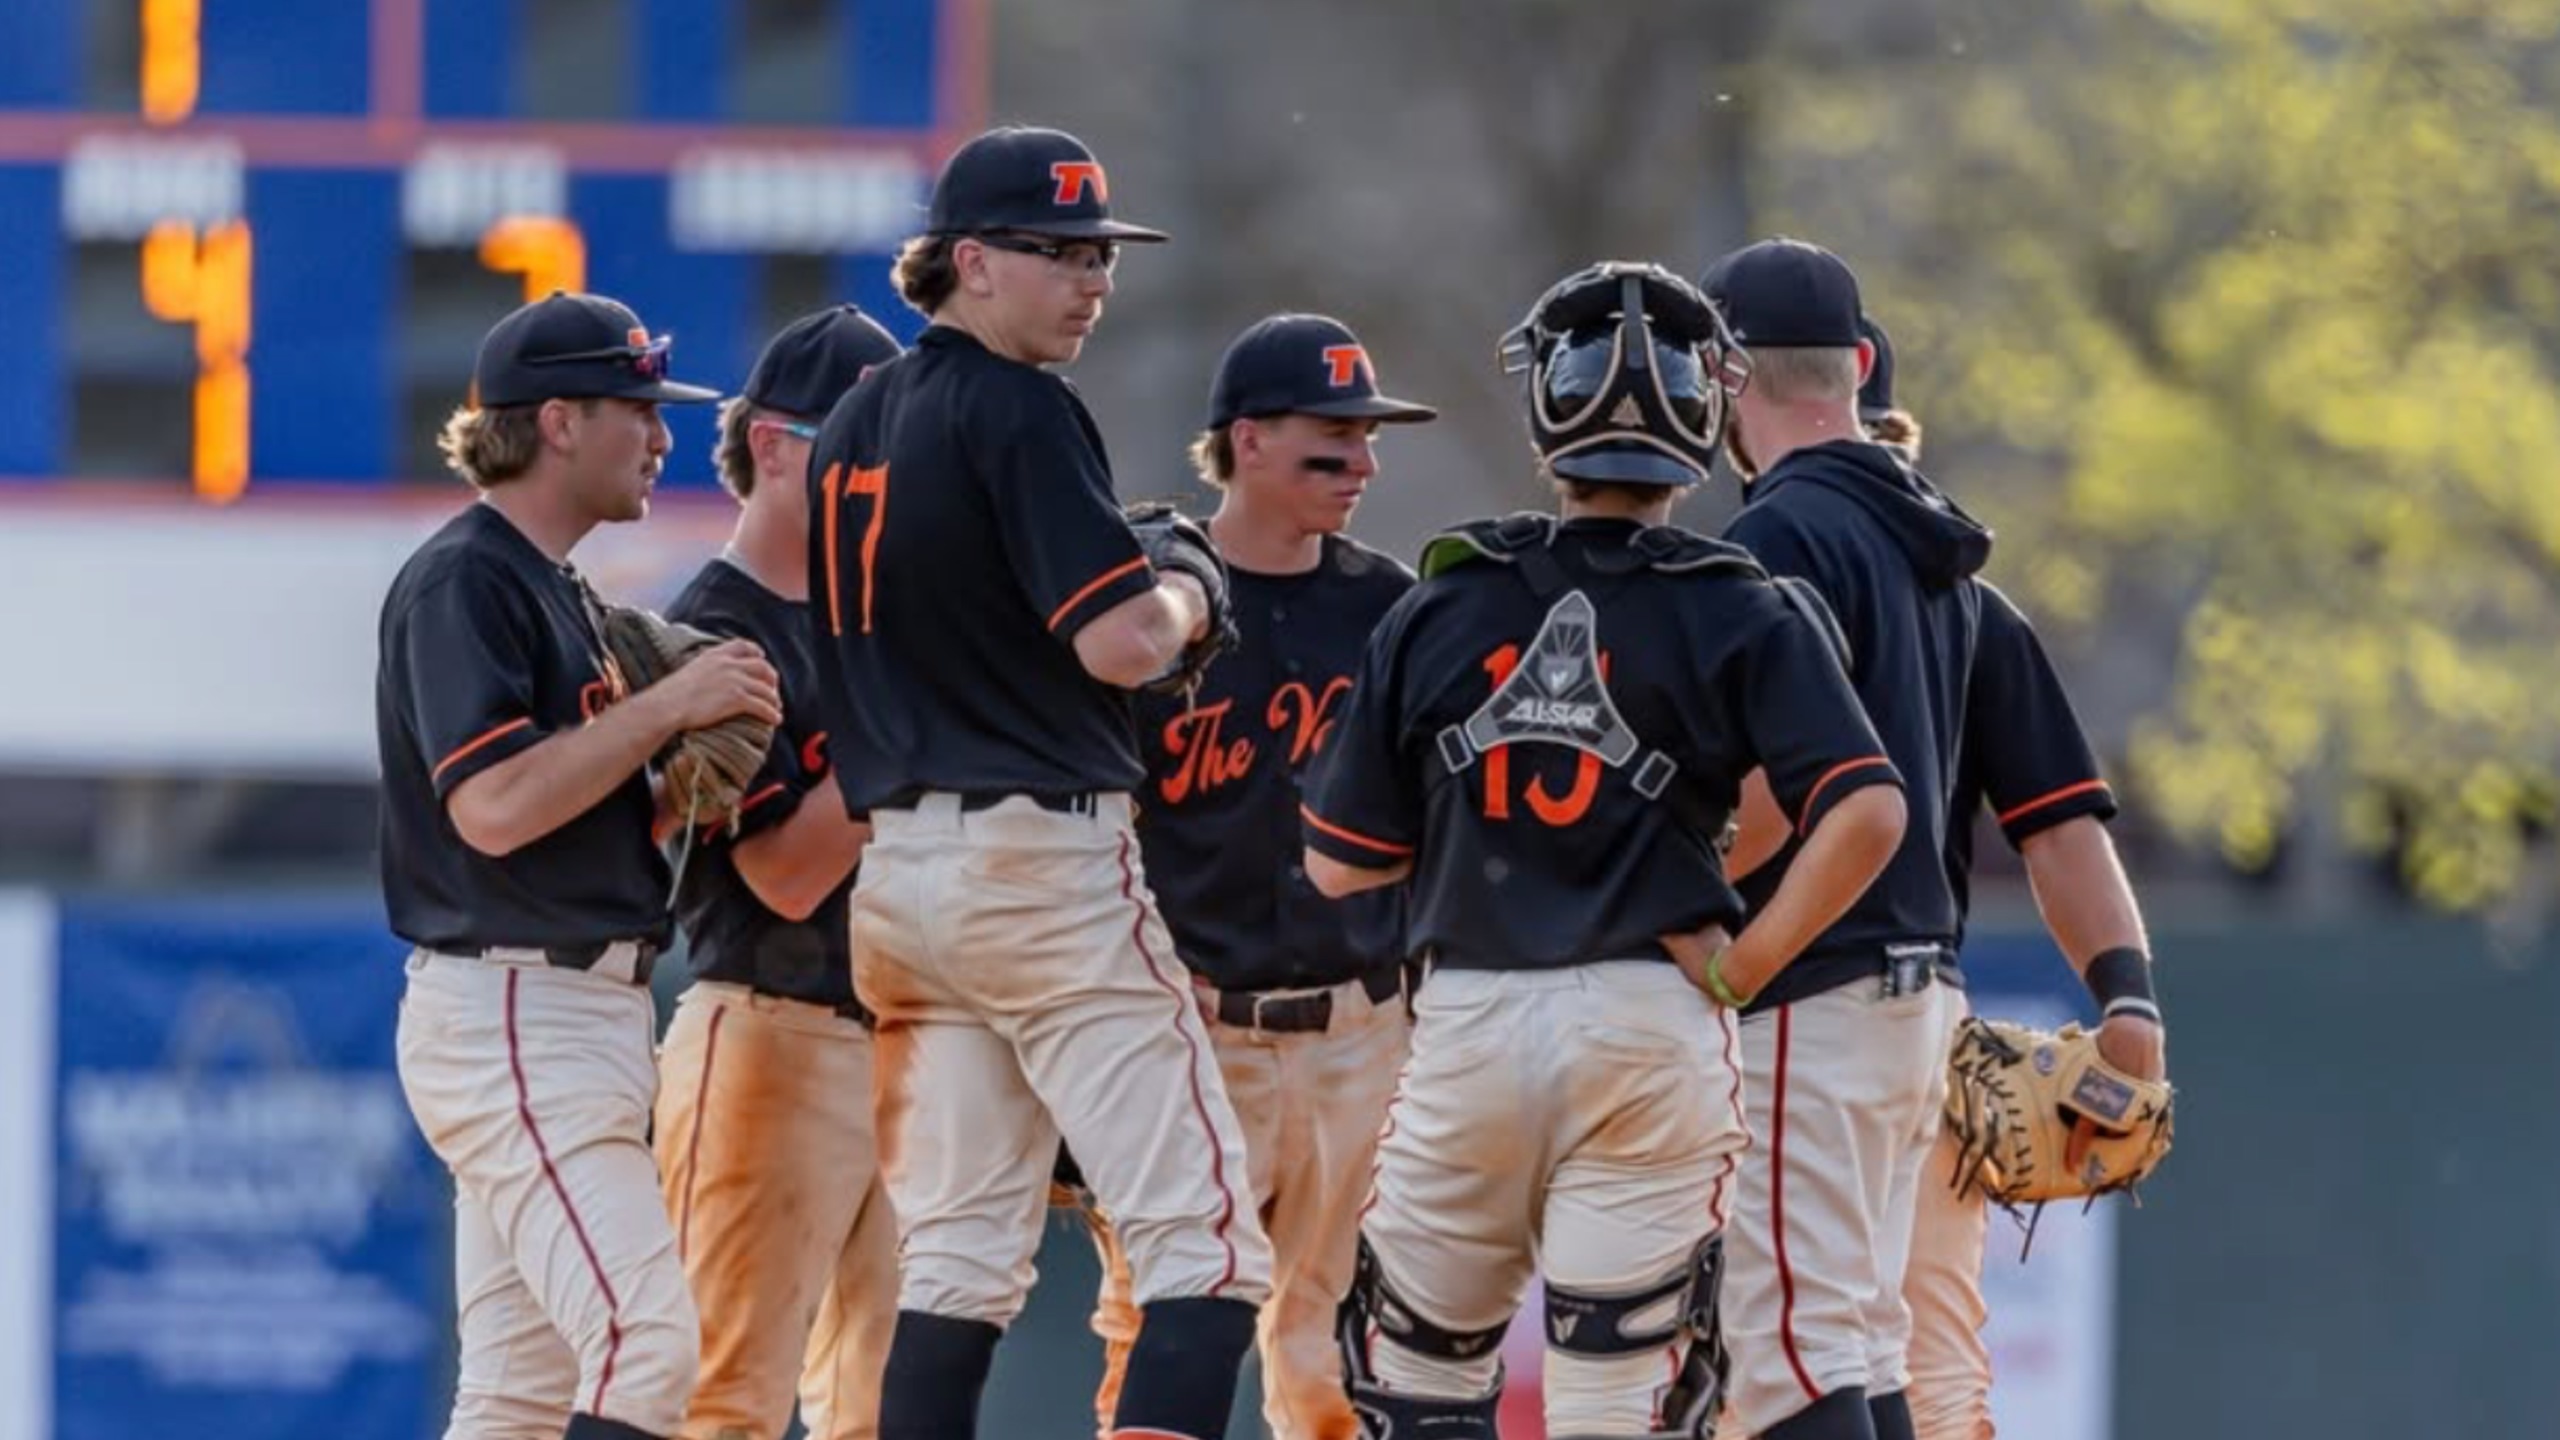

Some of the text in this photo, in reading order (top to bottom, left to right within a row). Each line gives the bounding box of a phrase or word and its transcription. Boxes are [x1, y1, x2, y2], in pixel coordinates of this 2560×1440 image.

[821, 458, 890, 637] 17
[1161, 675, 1353, 804] The V
